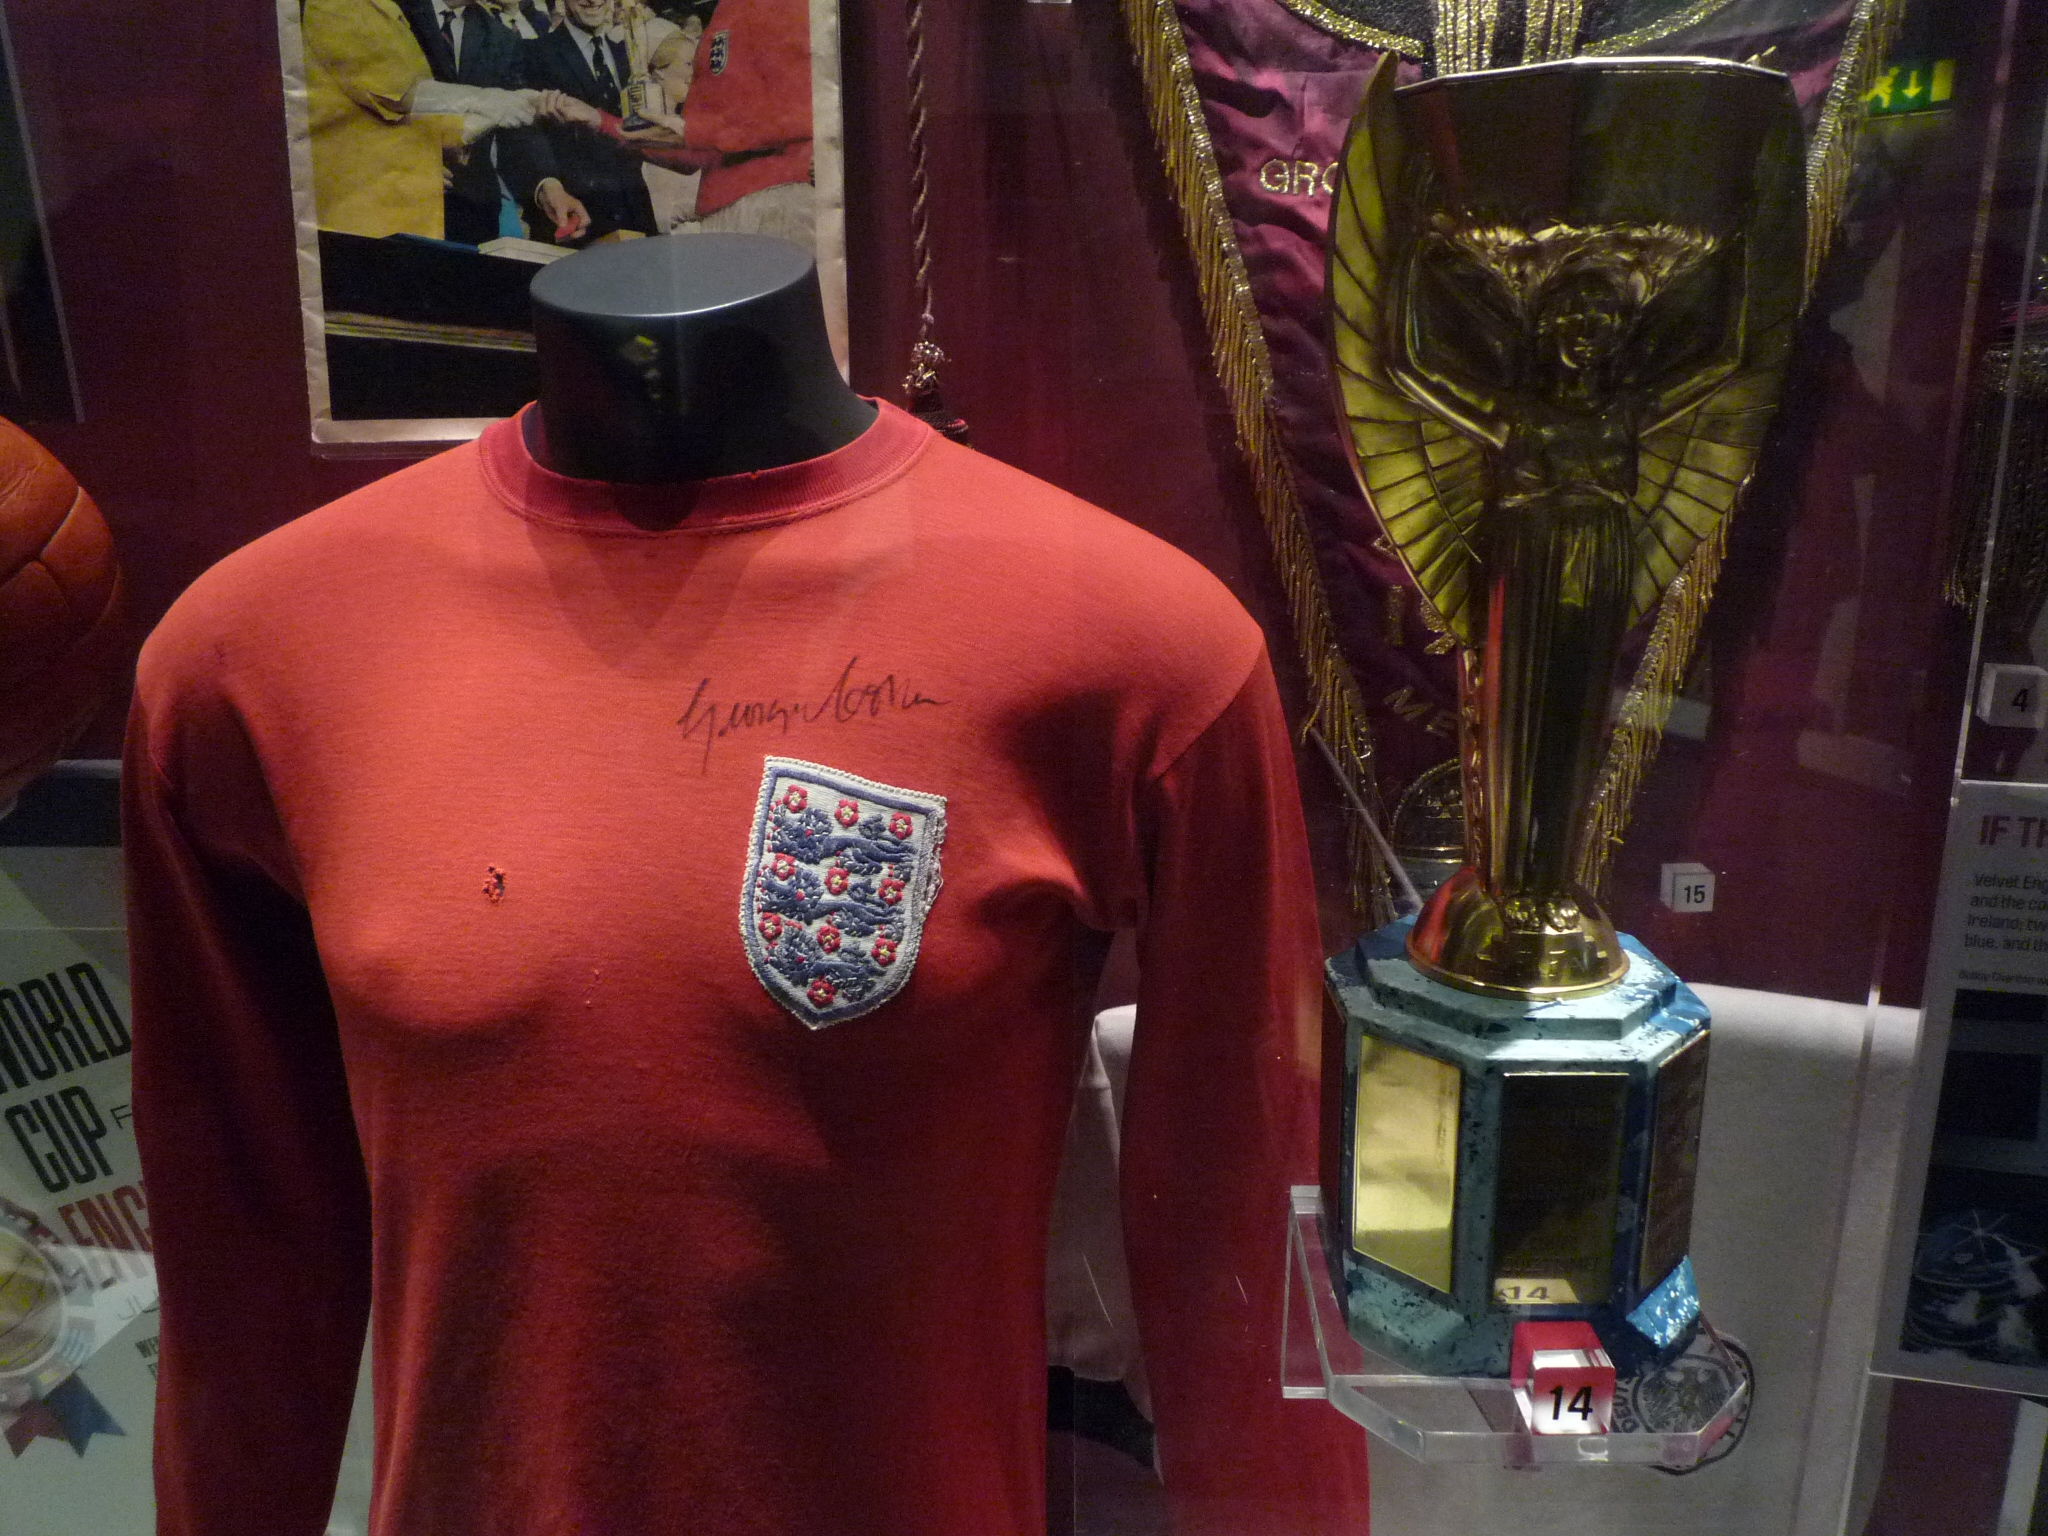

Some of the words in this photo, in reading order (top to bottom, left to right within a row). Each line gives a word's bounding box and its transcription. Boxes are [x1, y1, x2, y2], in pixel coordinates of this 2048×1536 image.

[2011, 689, 2029, 712] 4
[1979, 815, 2011, 846] IF
[1974, 873, 2020, 889] Velvet
[1683, 884, 1706, 904] 15
[1970, 895, 1997, 908] and
[2001, 895, 2025, 910] the
[2003, 936, 2031, 951] and
[5, 1085, 114, 1193] CUP
[1549, 1386, 1594, 1421] 14
